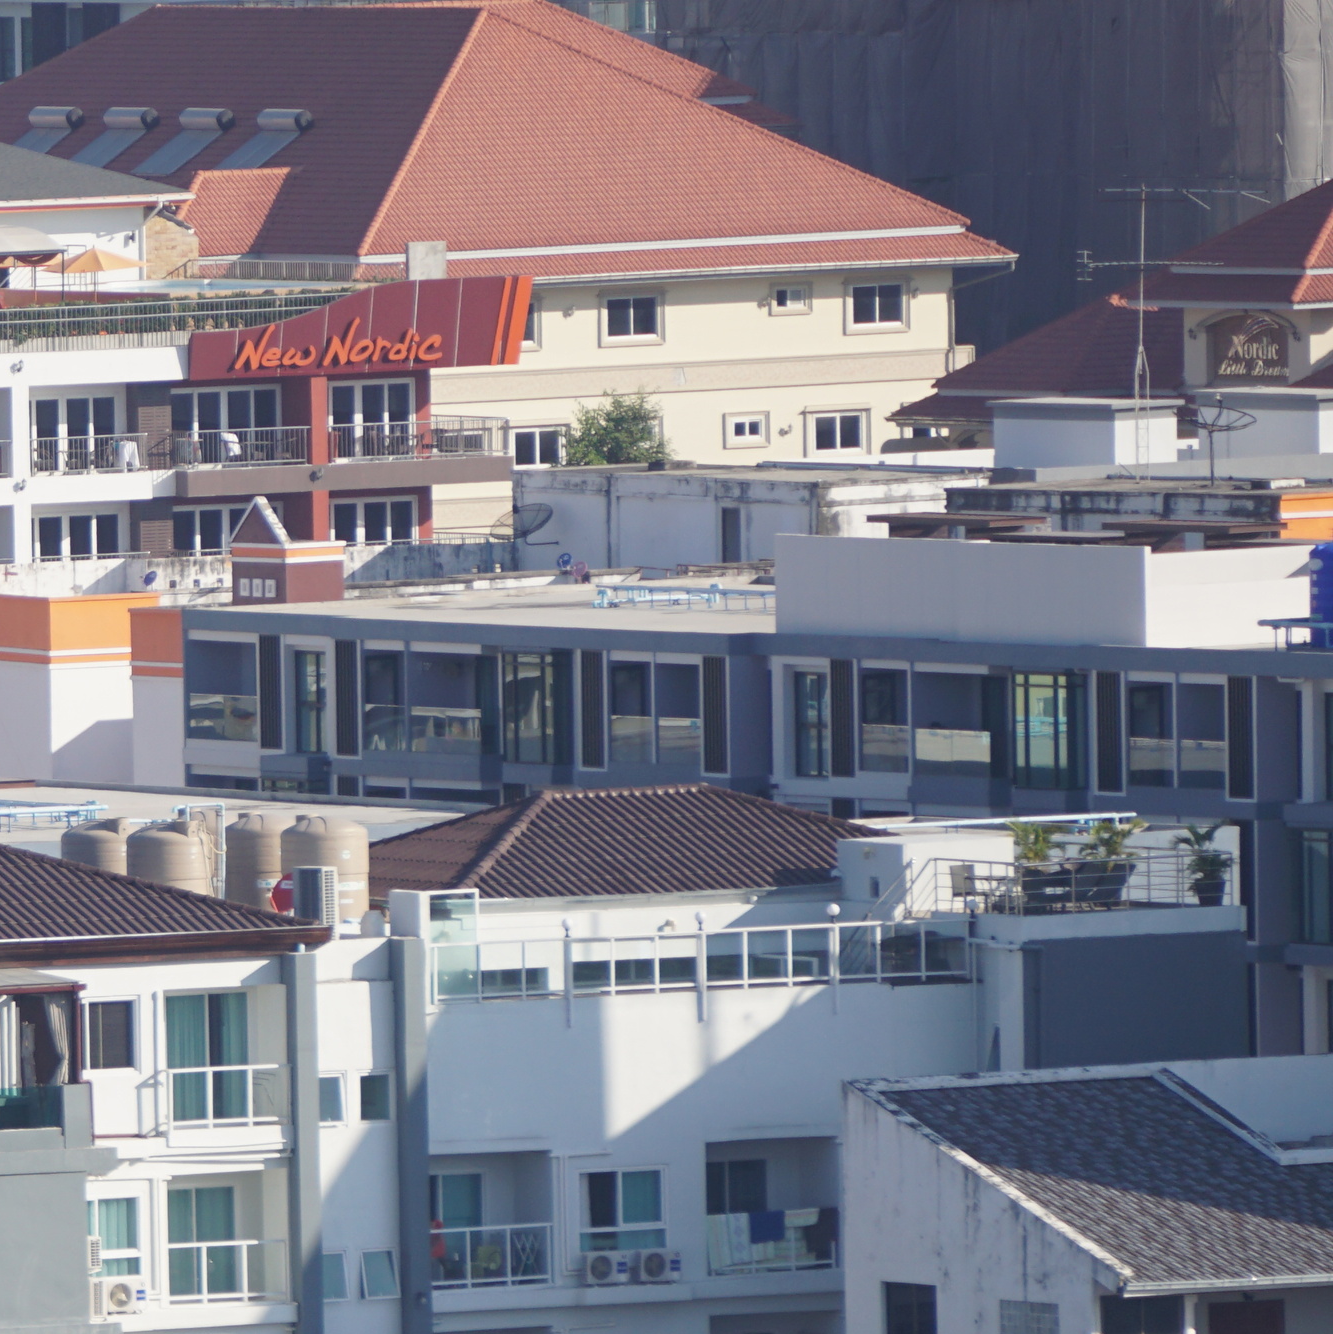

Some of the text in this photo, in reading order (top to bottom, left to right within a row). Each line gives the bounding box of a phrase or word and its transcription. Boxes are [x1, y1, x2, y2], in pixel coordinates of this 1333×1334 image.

[235, 317, 443, 371] New Nordic
[1228, 334, 1279, 360] Nordic
